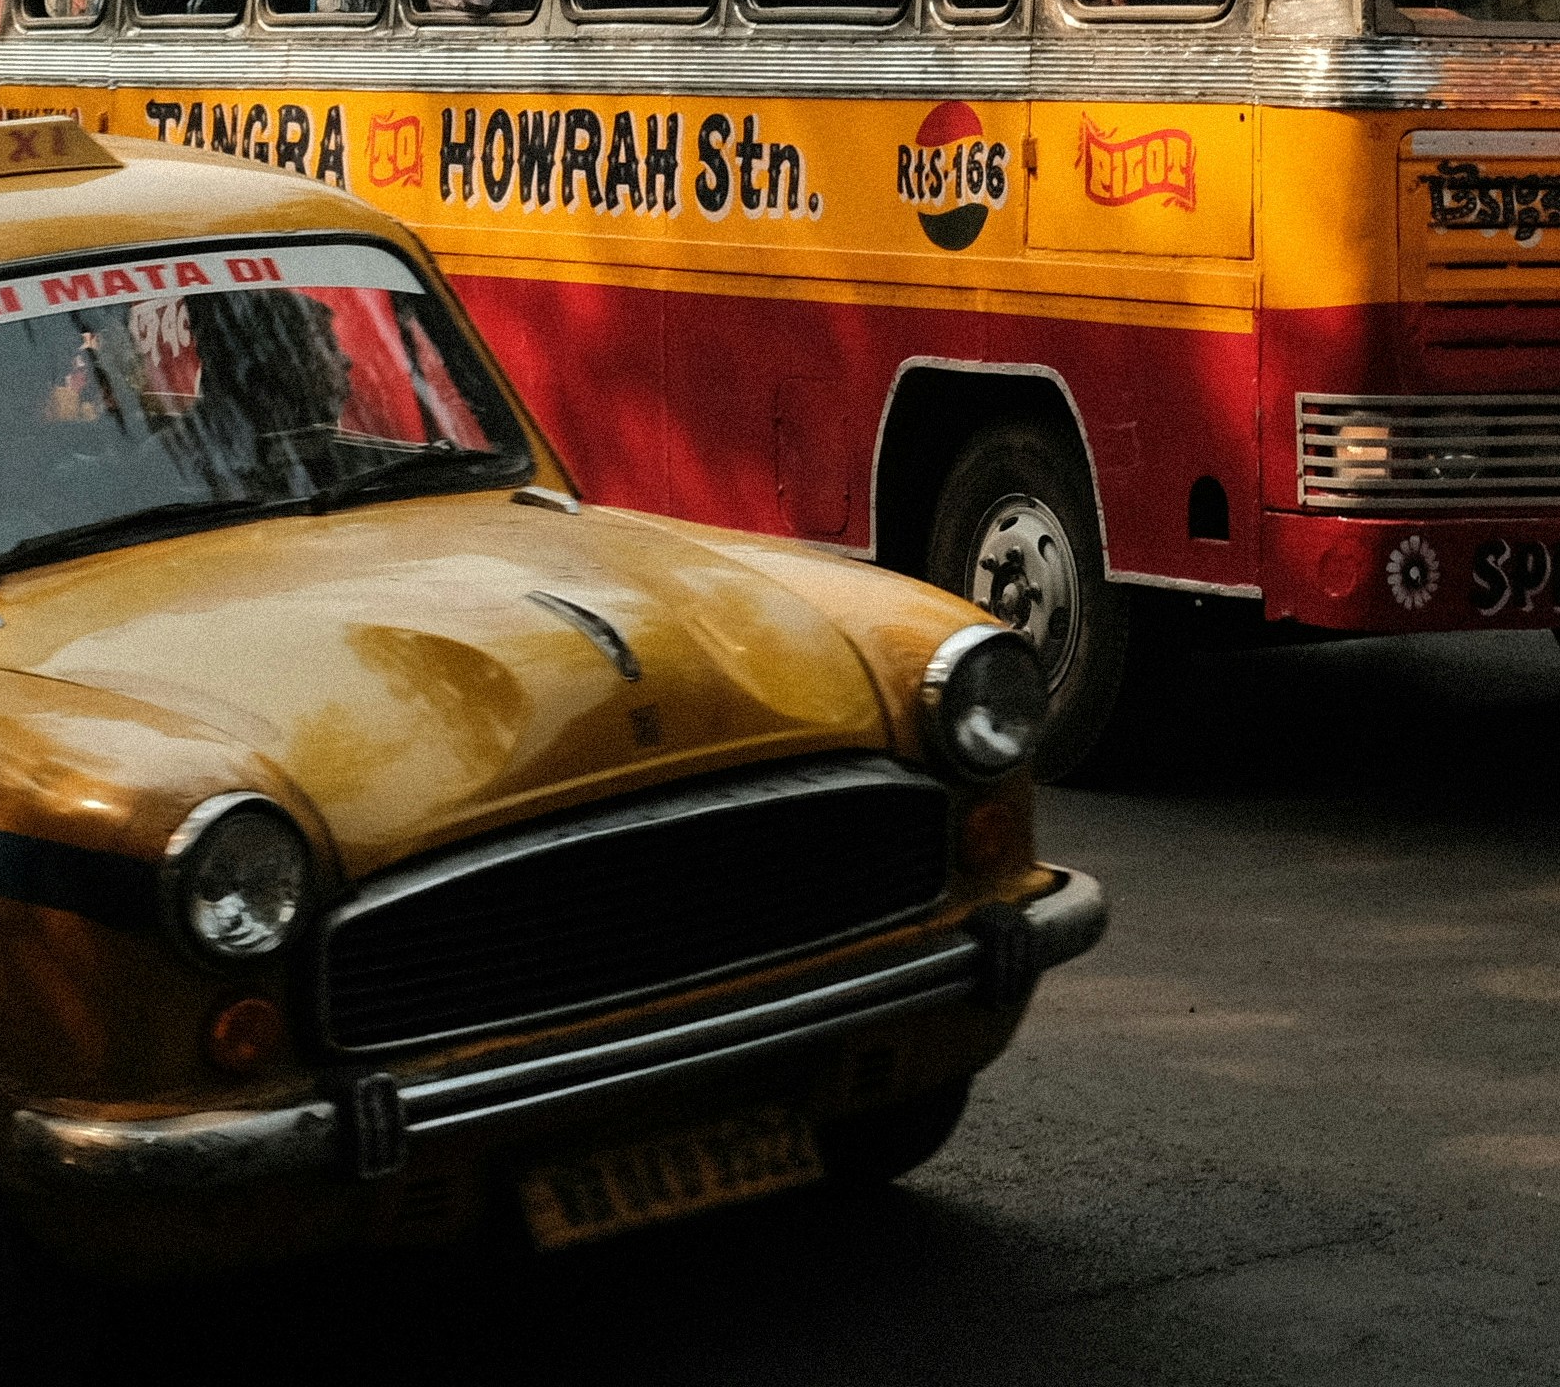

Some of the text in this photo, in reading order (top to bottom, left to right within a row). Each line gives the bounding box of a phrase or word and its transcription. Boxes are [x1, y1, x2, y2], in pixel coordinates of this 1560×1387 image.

[145, 99, 348, 192] TANGRA
[441, 106, 682, 221] HOWRAH
[693, 112, 824, 224] Stn.
[1087, 133, 1190, 202] PILOT
[39, 260, 212, 306] MATA
[224, 256, 282, 285] DI
